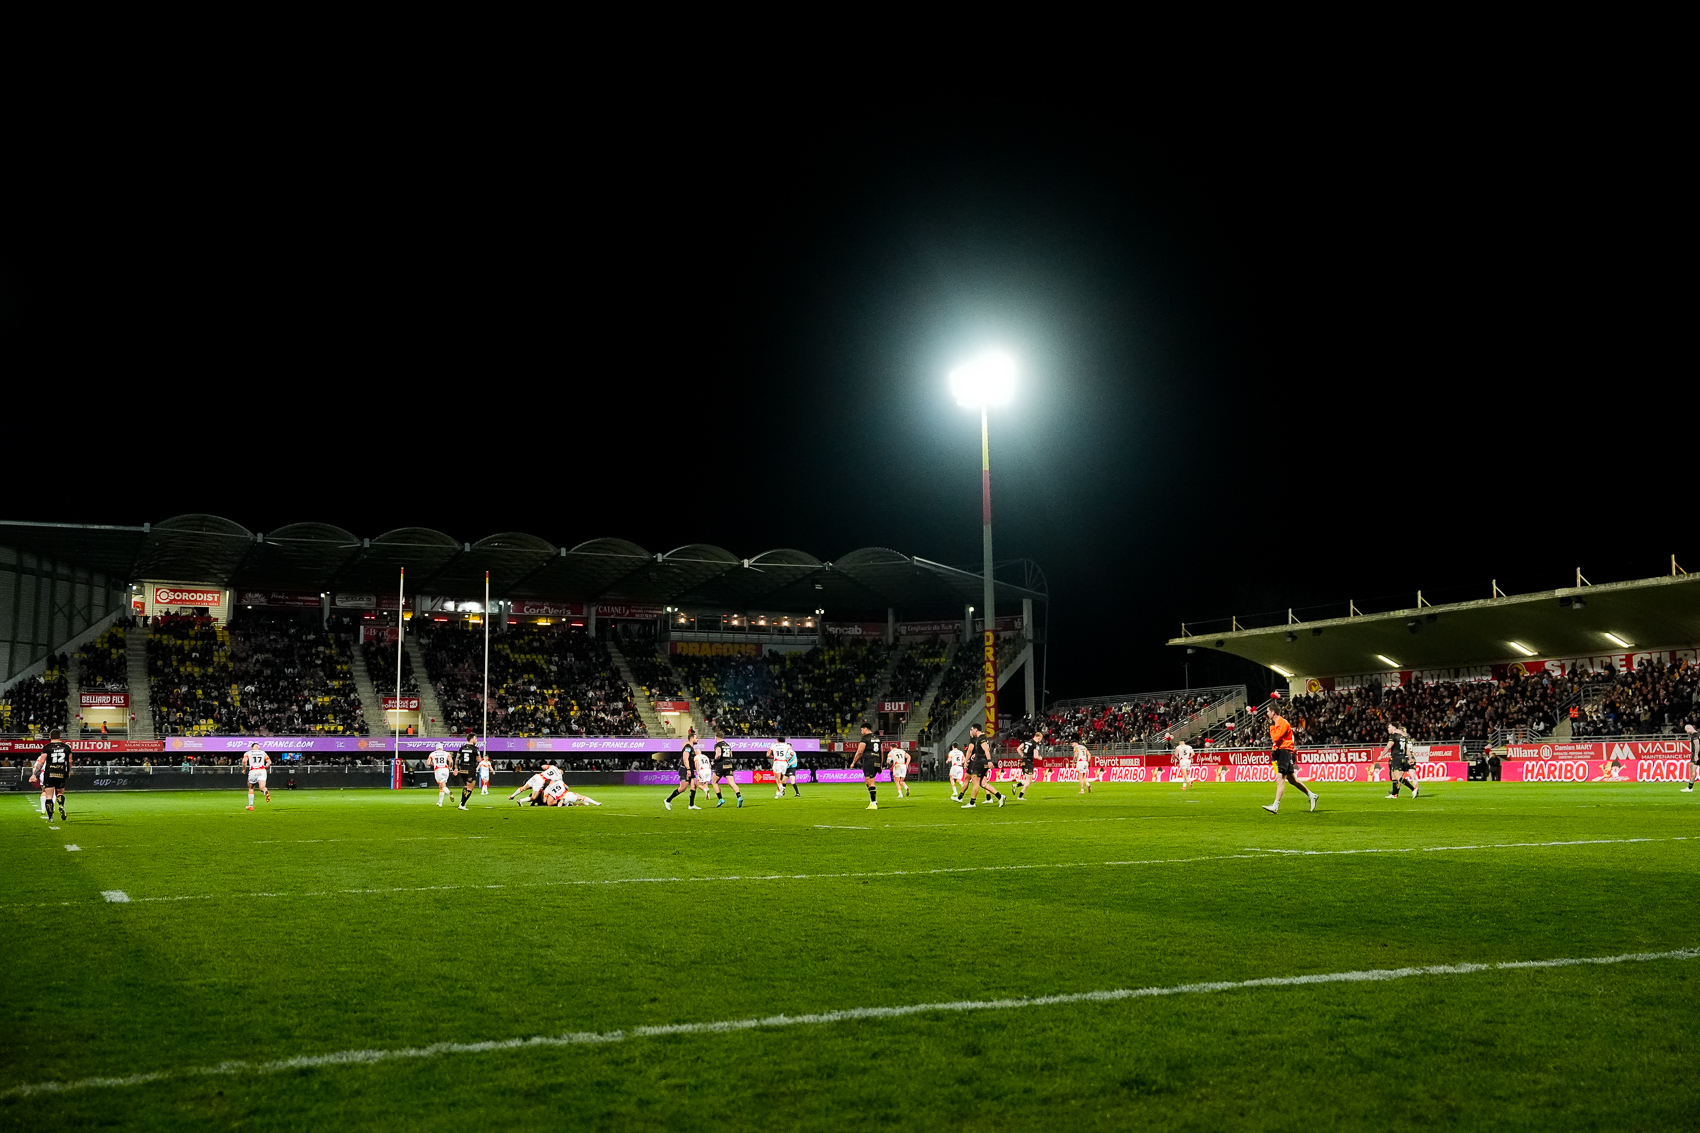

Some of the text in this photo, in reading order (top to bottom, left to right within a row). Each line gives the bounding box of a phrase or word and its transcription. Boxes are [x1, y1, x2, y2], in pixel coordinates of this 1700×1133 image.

[168, 592, 220, 602] SORODIST
[523, 606, 572, 615] Cars Verts
[676, 642, 756, 657] DRAGONS
[1544, 654, 1626, 678] STADE
[1334, 665, 1493, 691] DRAGONS CATALANS
[984, 631, 996, 738] DRAGONS
[81, 695, 125, 704] BELLIARD FILS
[884, 701, 906, 711] BUT
[226, 740, 314, 749] SUD-D-FRANCE.COM
[571, 741, 645, 749] SUD-DE-FRANCE.COM
[873, 742, 880, 752] 8
[50, 752, 66, 763] 12
[463, 753, 470, 762] 5
[1229, 752, 1270, 765] VillaVerde
[1301, 751, 1368, 763] DURAND & FILS
[1506, 747, 1539, 758] Allianz
[434, 756, 445, 764] 18
[1095, 756, 1119, 768] Peyrot
[1110, 766, 1146, 783] HARIBO
[1169, 766, 1208, 783] HAIBO
[1235, 766, 1277, 783] HARIBO
[1309, 763, 1357, 782] HARIBO
[1523, 760, 1588, 782] HARIBO
